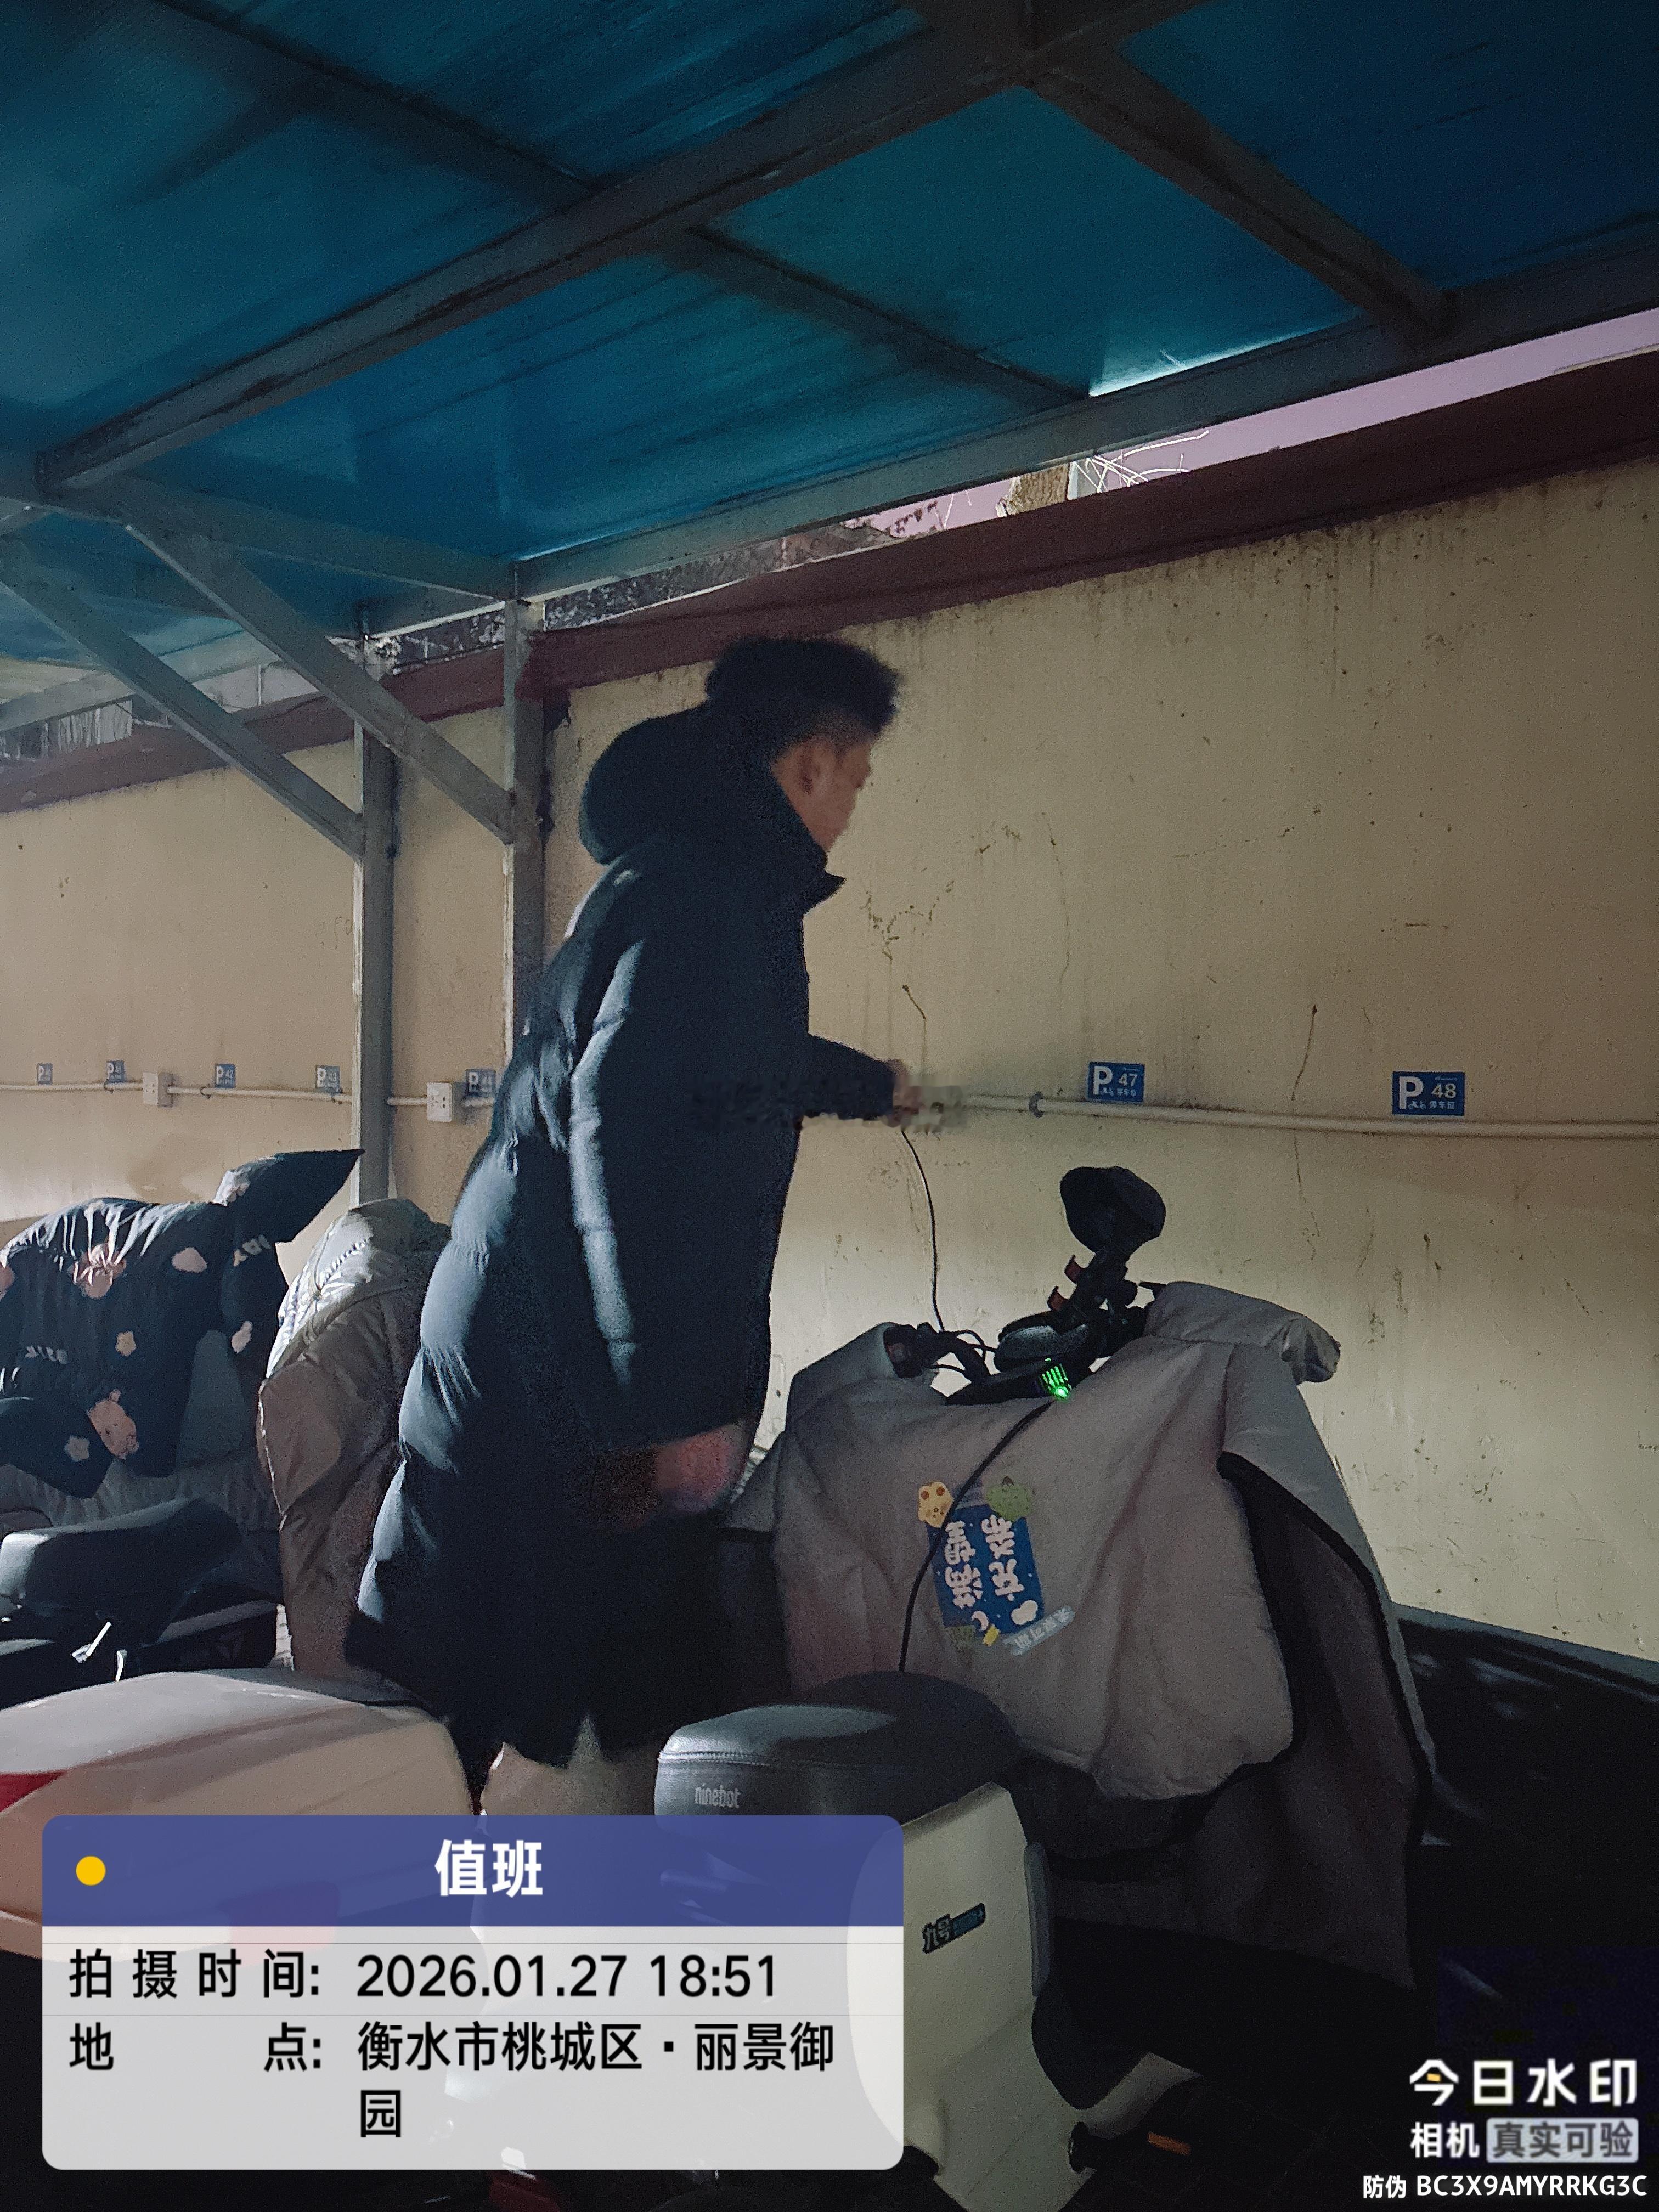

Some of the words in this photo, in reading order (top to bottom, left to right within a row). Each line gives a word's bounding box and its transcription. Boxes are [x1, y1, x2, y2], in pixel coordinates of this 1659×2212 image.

[317, 1068, 326, 1087] P
[1093, 1066, 1113, 1095] P
[1118, 1073, 1137, 1087] 47
[1399, 1076, 1424, 1109] P
[1431, 1083, 1457, 1099] 48
[694, 1782, 741, 1809] ninebot
